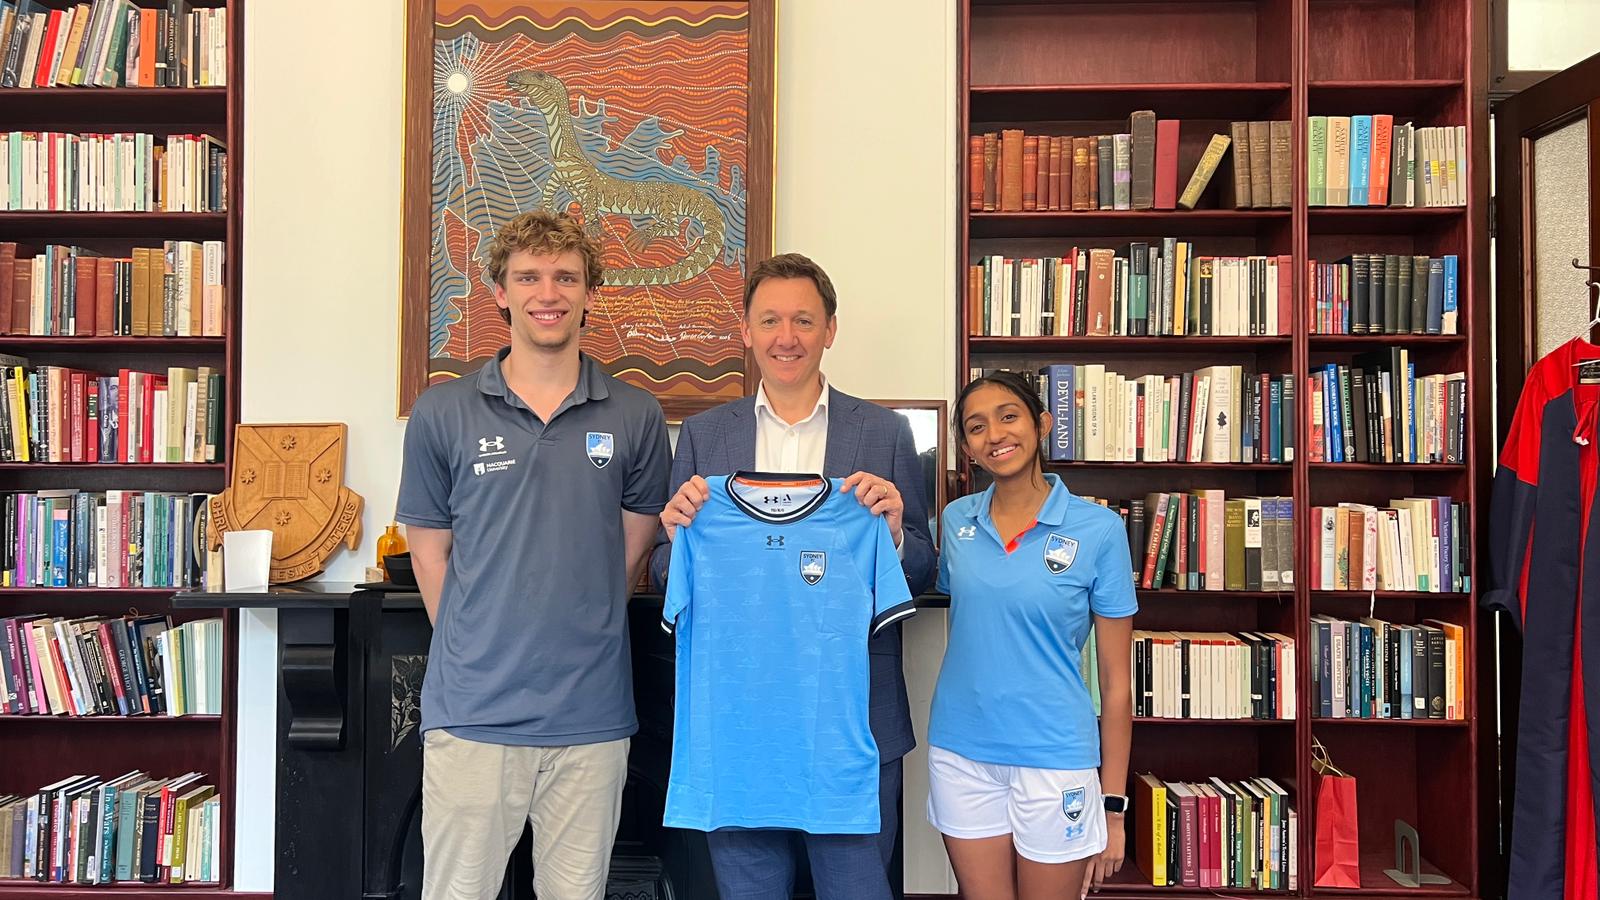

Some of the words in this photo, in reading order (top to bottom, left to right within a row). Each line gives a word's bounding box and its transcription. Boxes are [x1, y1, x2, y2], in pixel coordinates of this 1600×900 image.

[1057, 381, 1068, 449] DEVIL-LAND
[1051, 536, 1075, 547] SYDNEY
[1150, 523, 1161, 558] CLOUGH
[105, 793, 113, 801] In
[104, 814, 112, 834] Wars
